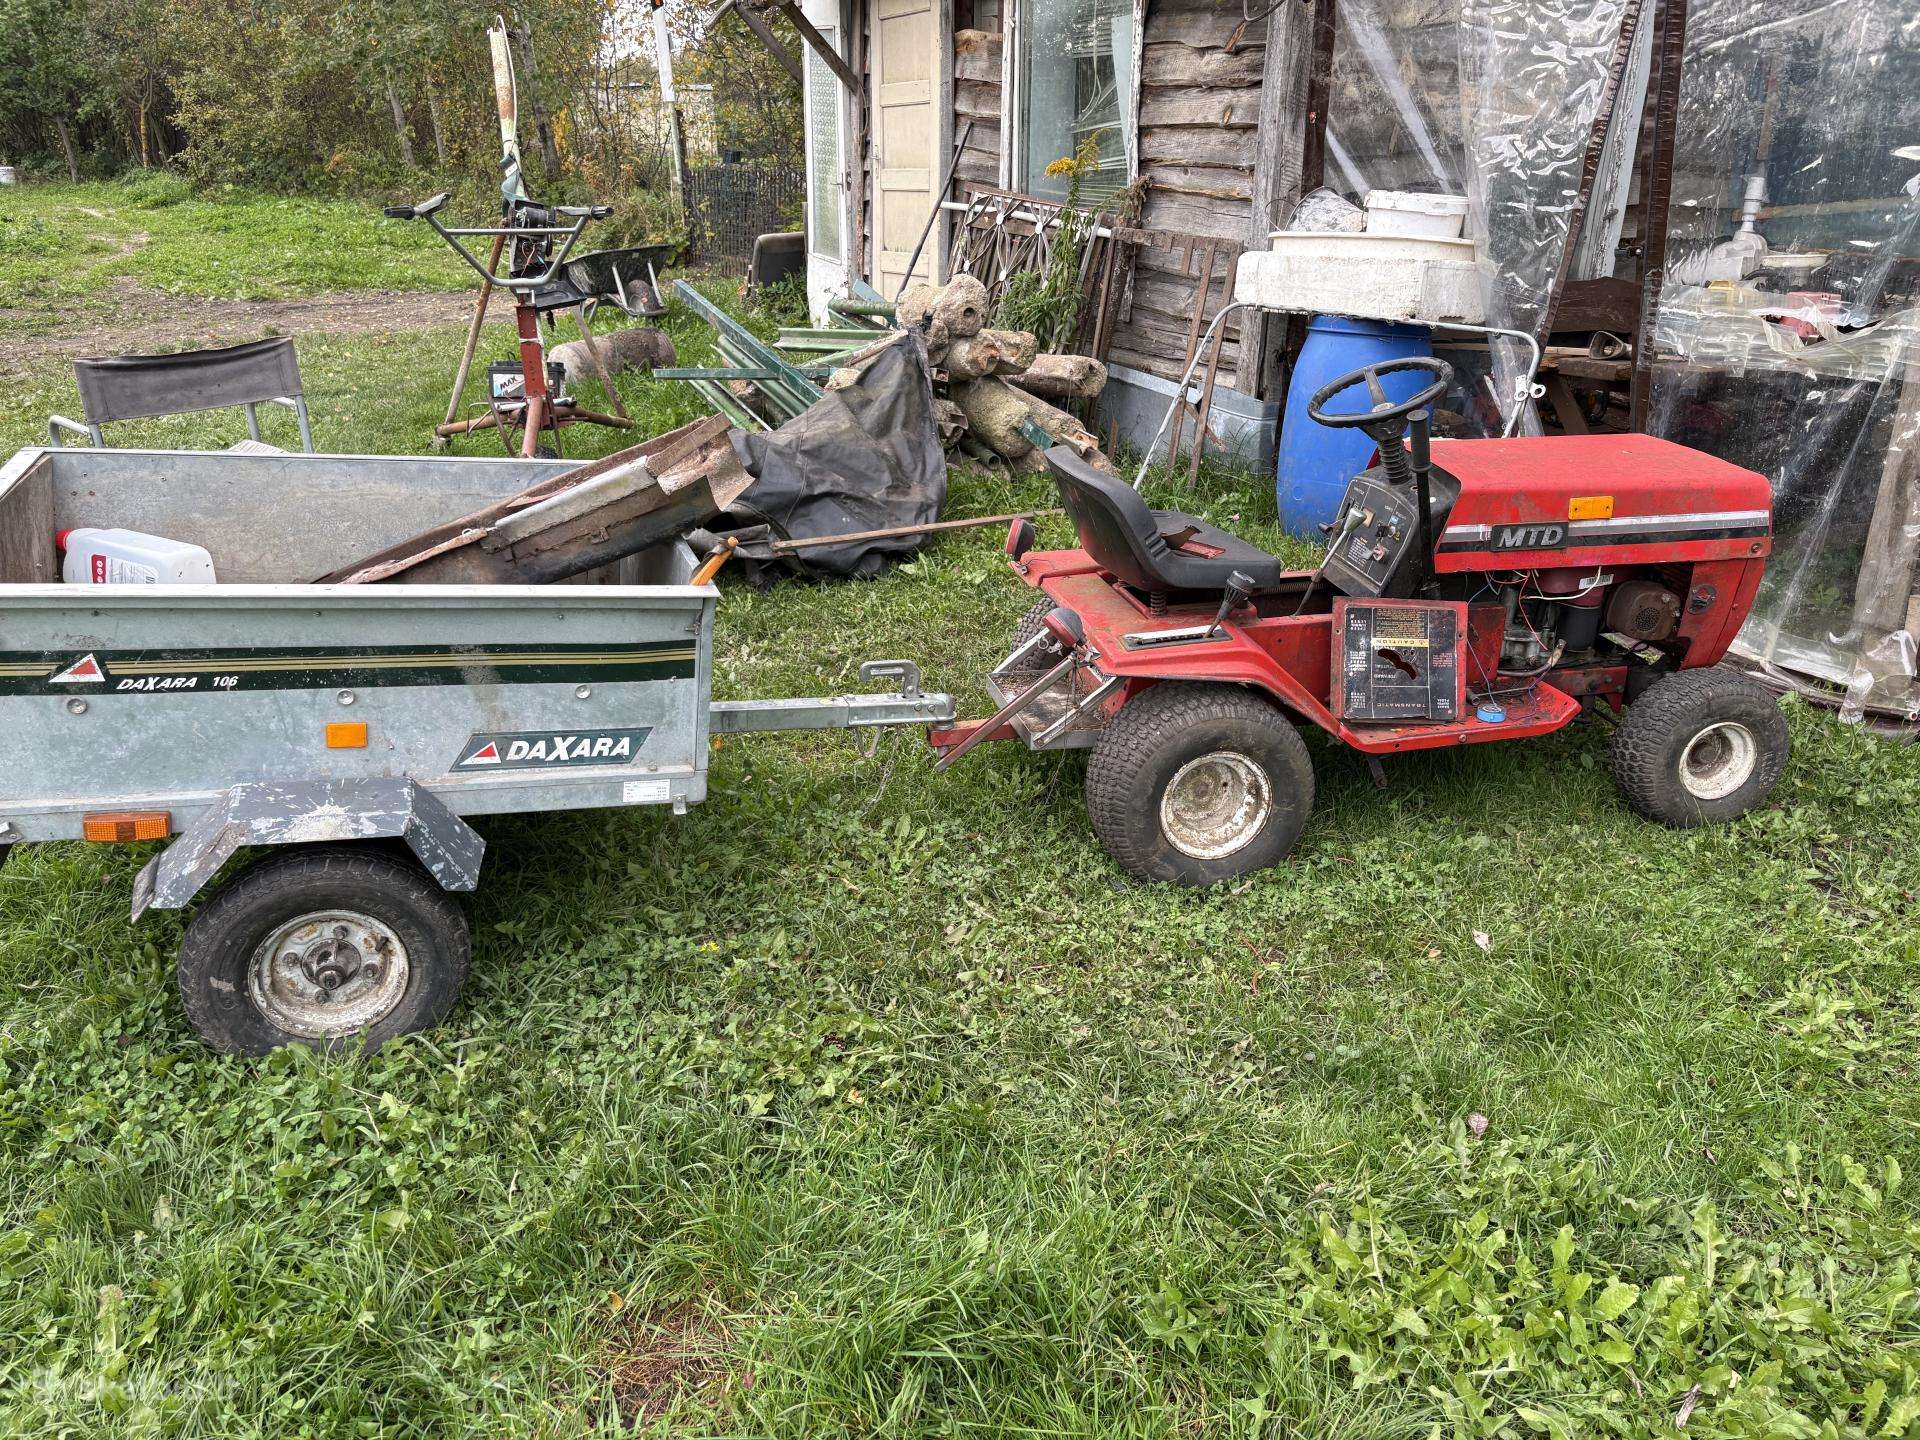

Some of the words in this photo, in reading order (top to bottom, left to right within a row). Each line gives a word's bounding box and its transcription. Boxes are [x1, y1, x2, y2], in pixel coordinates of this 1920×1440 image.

[500, 375, 518, 390] MAX
[1496, 525, 1564, 548] MTD
[116, 677, 198, 691] DAXARA
[213, 676, 239, 687] 106
[506, 736, 630, 762] DAXARA
